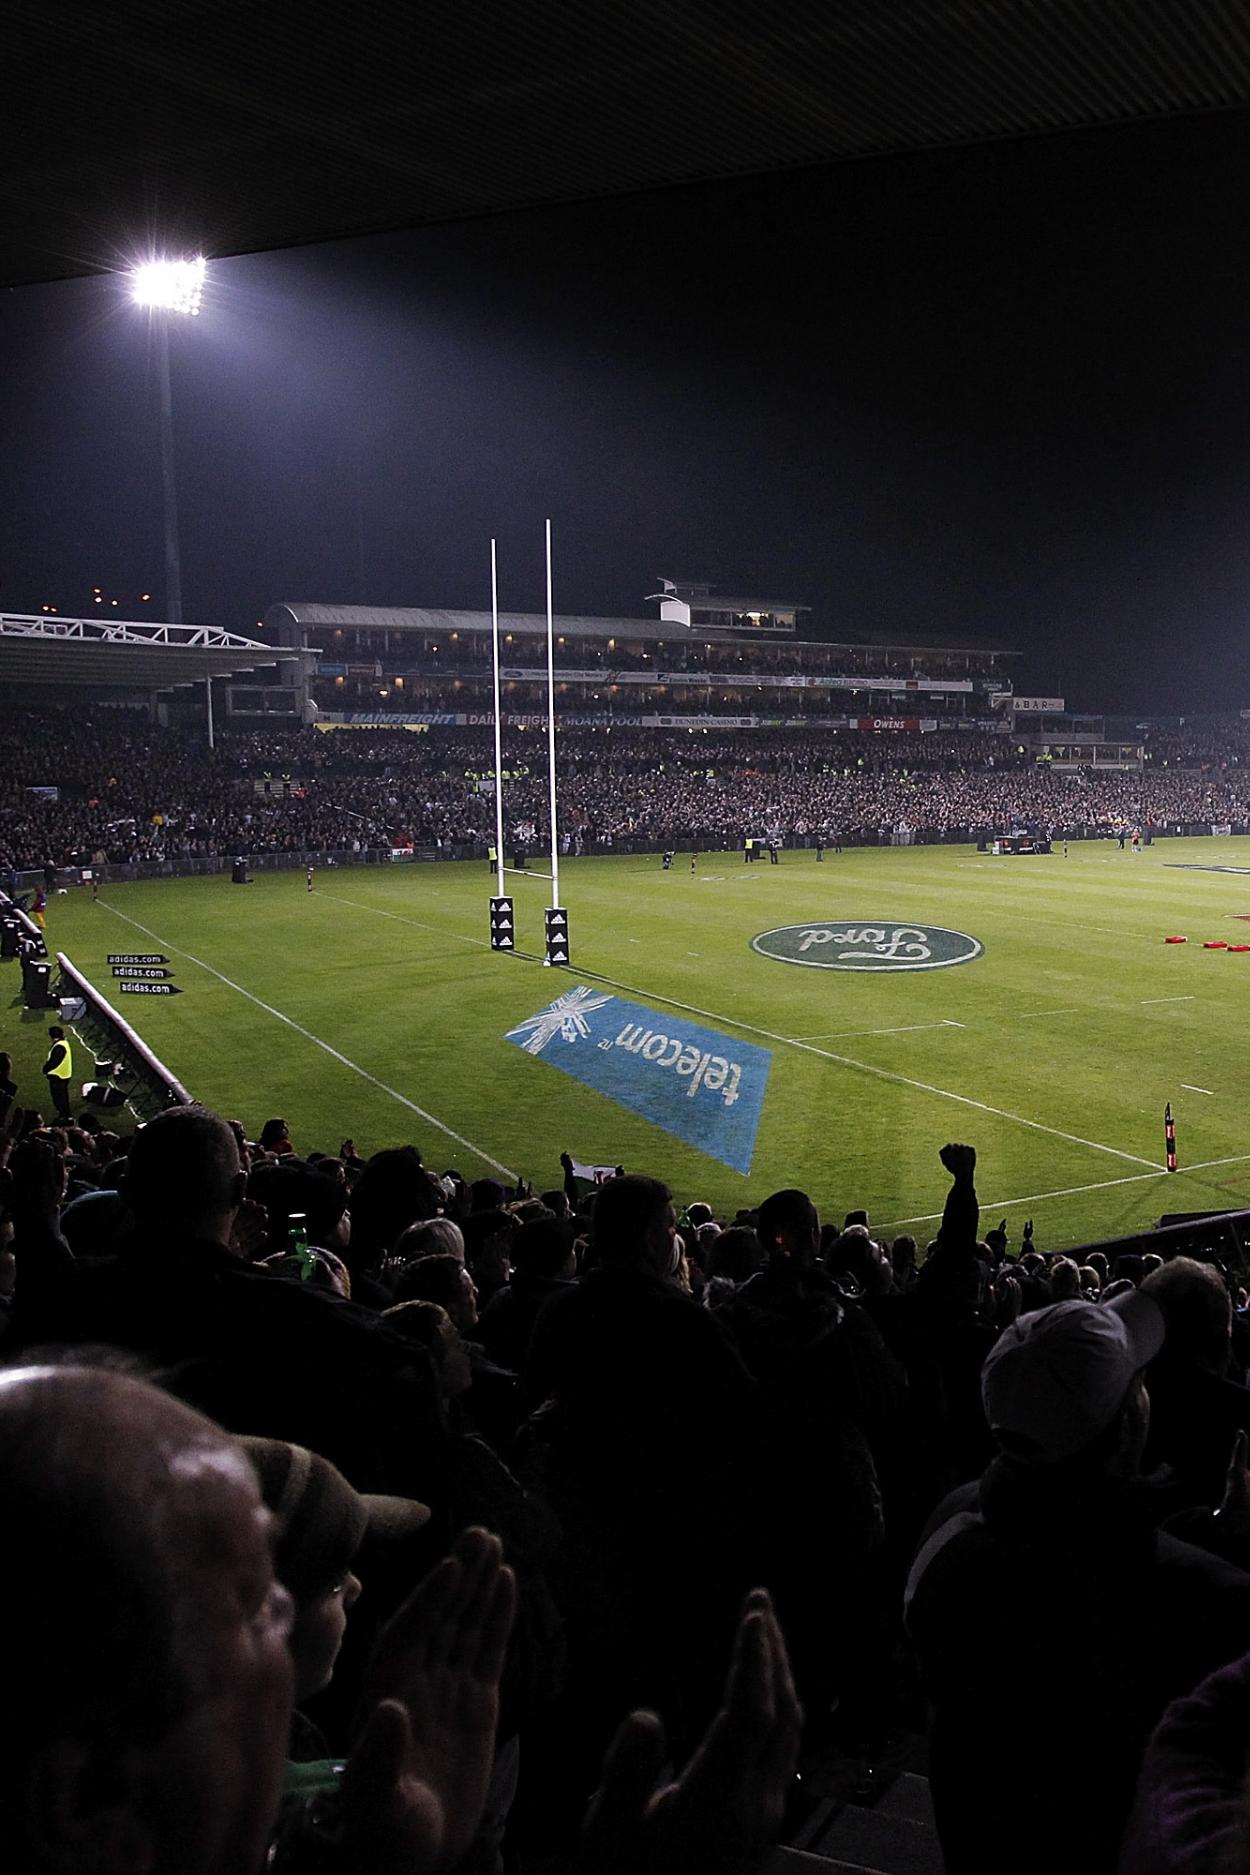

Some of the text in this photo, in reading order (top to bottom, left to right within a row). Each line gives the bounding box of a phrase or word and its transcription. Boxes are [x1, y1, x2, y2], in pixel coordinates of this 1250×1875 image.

[350, 713, 454, 724] MAINFREIGHT
[508, 715, 558, 726] FREIGH
[610, 717, 643, 727] POOL
[873, 719, 905, 729] OWENS
[798, 928, 932, 961] Ford
[114, 968, 164, 977] adidas.com
[121, 983, 170, 993] adidas.com
[614, 1022, 742, 1106] telecom
